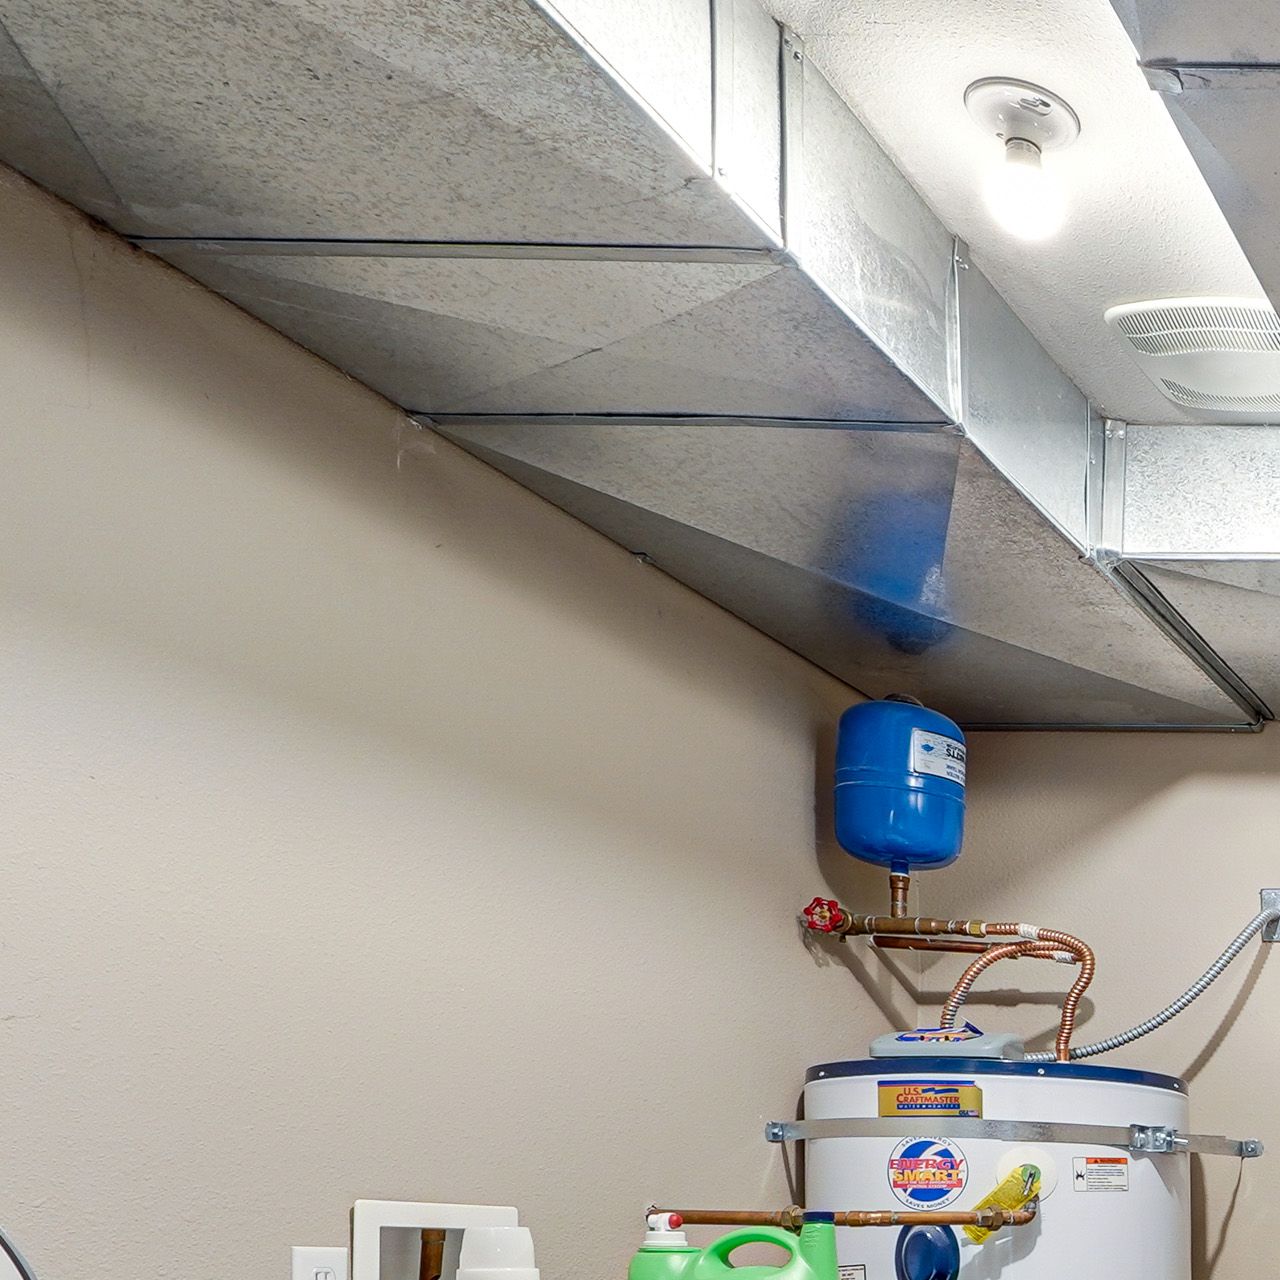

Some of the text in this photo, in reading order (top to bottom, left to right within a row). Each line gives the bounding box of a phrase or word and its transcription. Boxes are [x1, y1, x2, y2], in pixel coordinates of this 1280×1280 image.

[903, 1087, 921, 1096] U.S.
[896, 1094, 960, 1103] CRAFTMASTER
[890, 1159, 965, 1170] ENERGY
[894, 1169, 960, 1182] SMART
